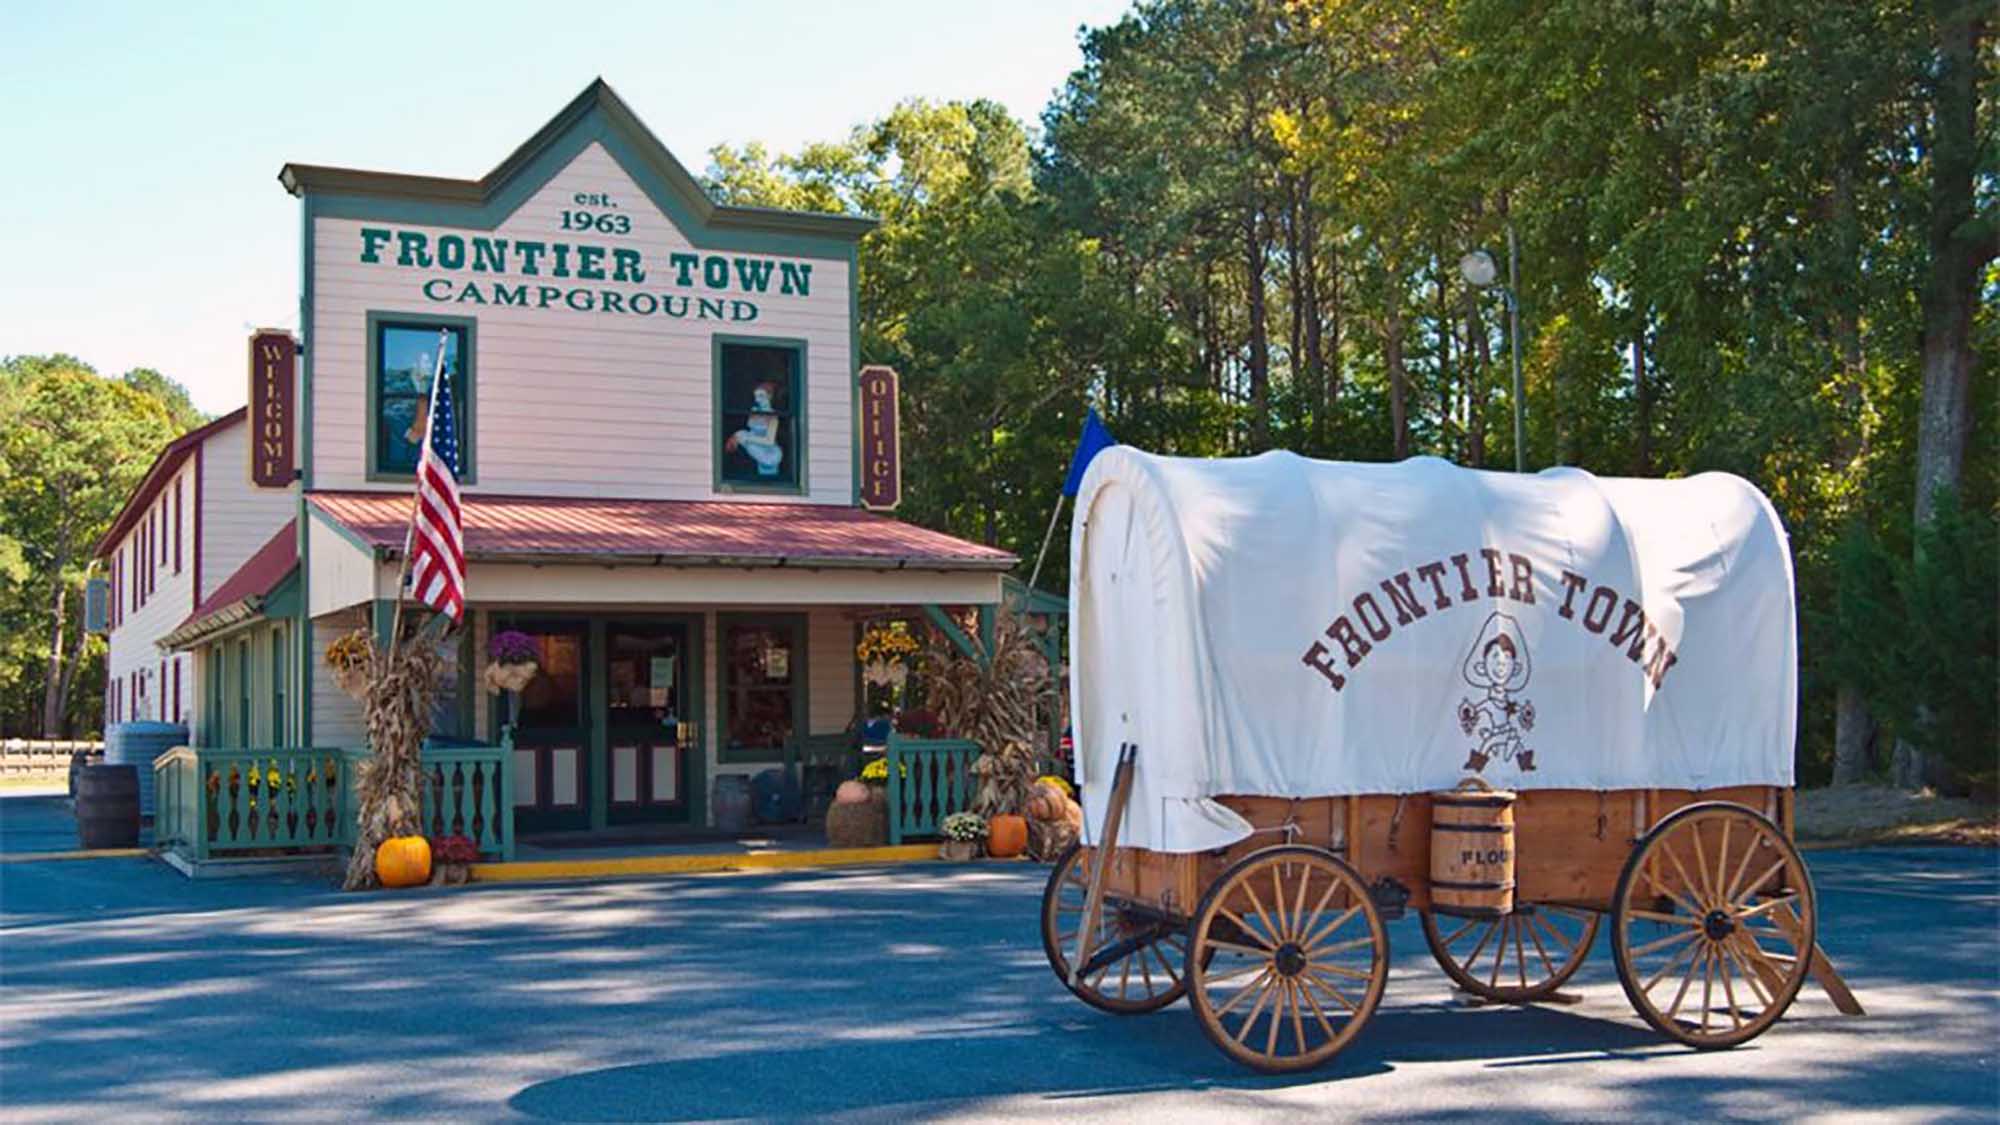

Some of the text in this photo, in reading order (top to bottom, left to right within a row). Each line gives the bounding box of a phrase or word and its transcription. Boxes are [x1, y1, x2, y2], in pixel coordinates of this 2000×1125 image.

[573, 192, 618, 208] est.
[561, 211, 631, 234] 1963
[360, 228, 813, 296] FRONTIER TOWN
[422, 279, 759, 321] CAMPGROUND
[1302, 548, 1678, 691] FRONTIER TOWN
